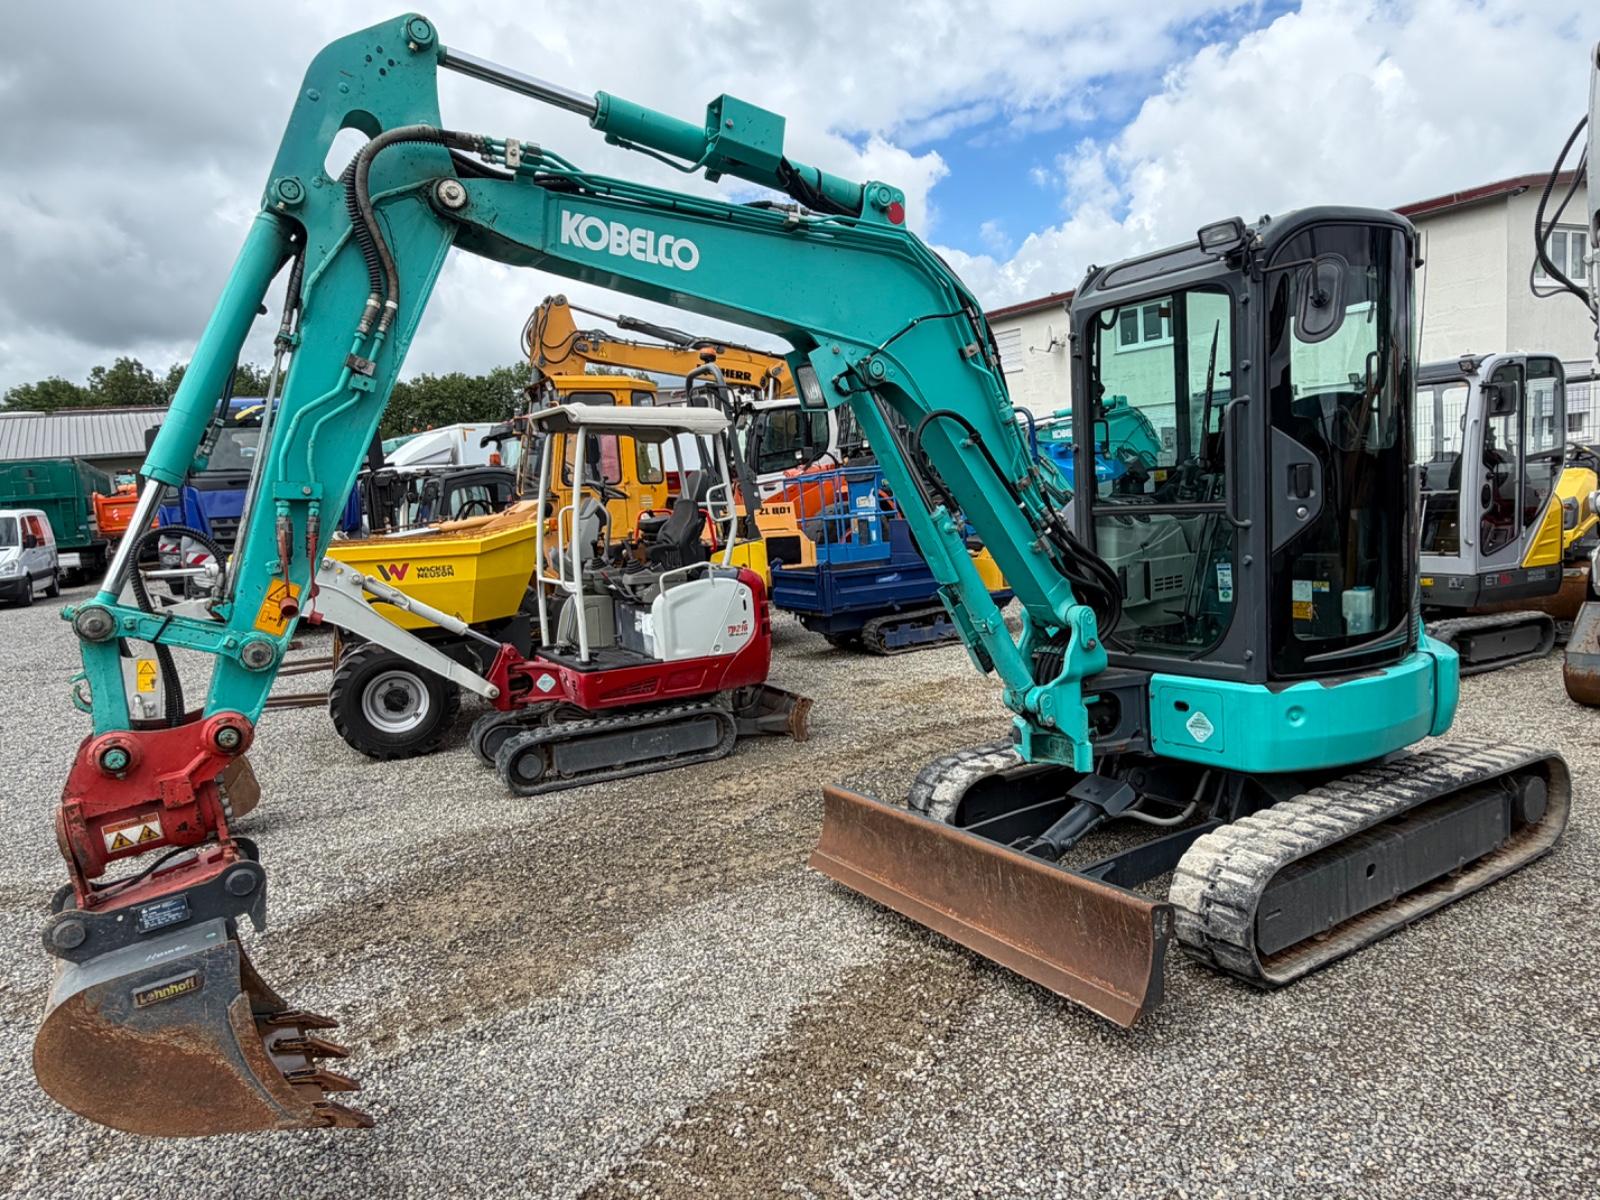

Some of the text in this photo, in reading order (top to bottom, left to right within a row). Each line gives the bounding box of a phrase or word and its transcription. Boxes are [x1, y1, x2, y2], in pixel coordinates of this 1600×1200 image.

[560, 209, 700, 272] KOBELCO
[759, 507, 770, 515] ZL
[417, 570, 455, 579] NEUSON
[138, 976, 196, 1006] Lehnhoff
